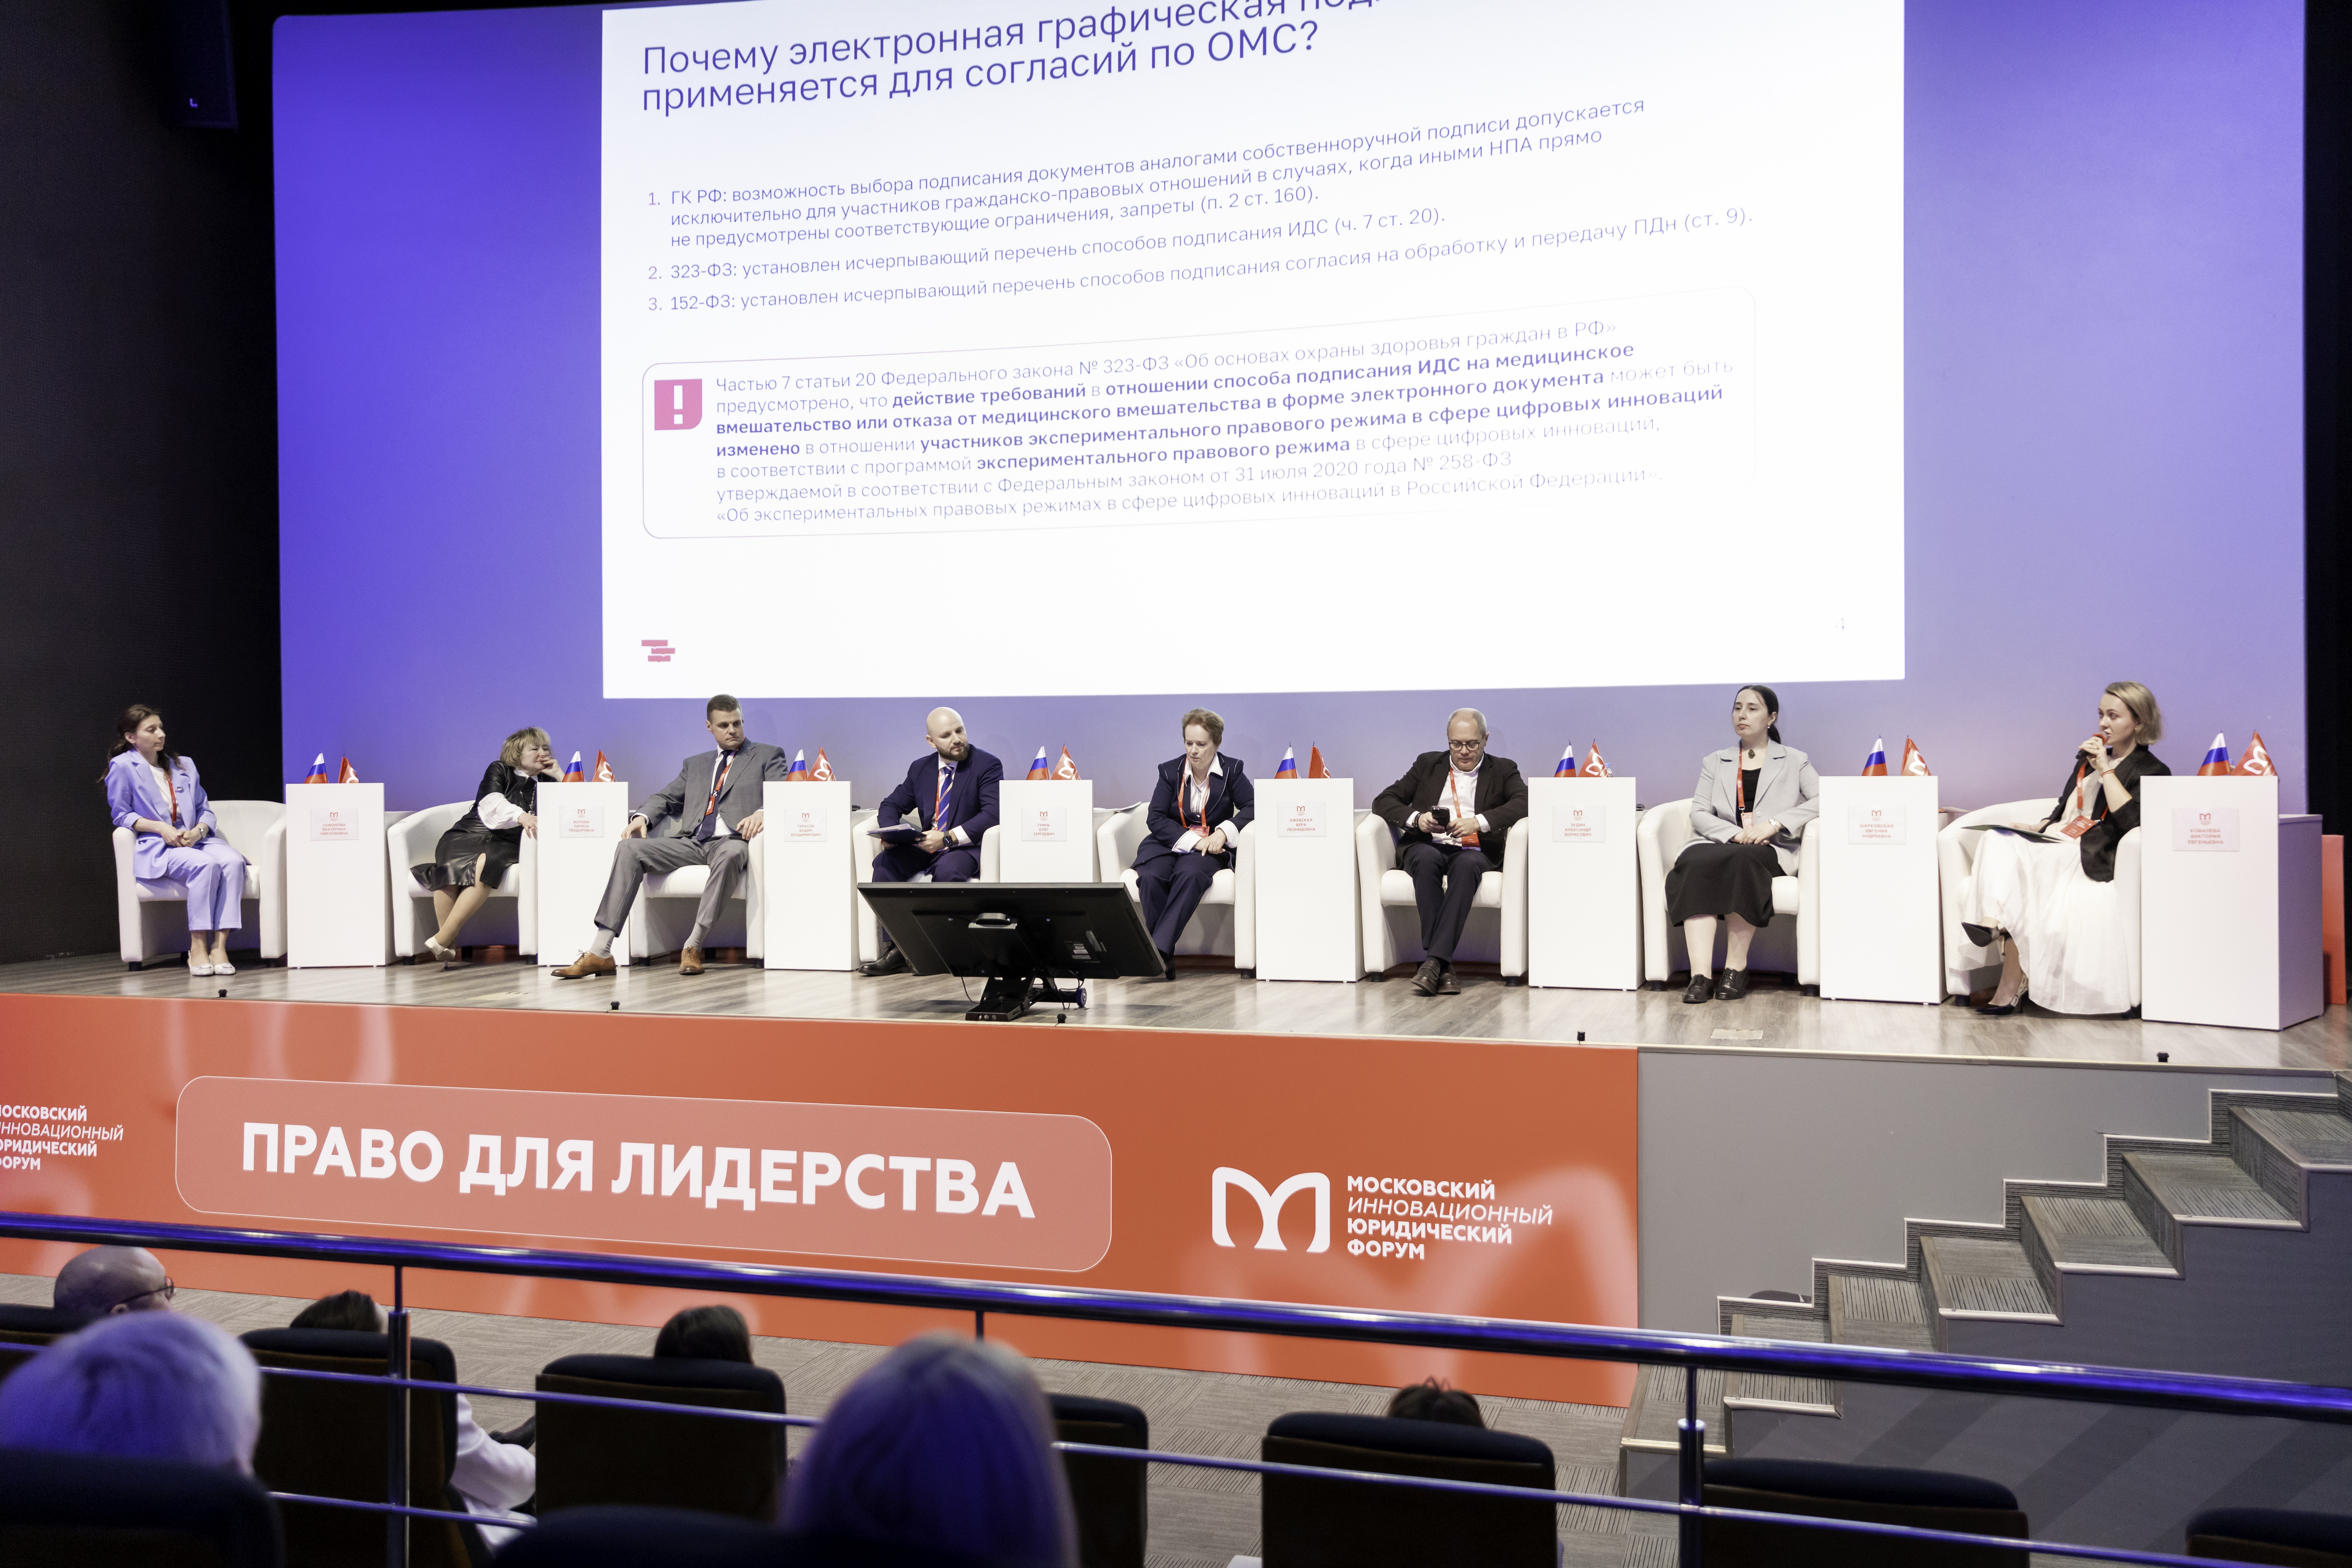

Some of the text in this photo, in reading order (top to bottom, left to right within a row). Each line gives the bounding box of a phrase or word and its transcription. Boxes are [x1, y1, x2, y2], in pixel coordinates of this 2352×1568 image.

[644, 20, 1317, 117] применяется для согласий по ОМС?
[645, 0, 1285, 75] Почему электронная графическая
[649, 100, 1643, 205] 1. ГК РФ: возможность выбора подписания документов аналогами собственноручной подписи допускается
[672, 131, 1601, 225] исключительно для участников гражданско-правовых отношений в случаях, когда иными НПА прямо
[649, 208, 1444, 279] 2. 323-ФЗ: установлен исчерпывающий перечень способов подписания ИДС (ч. 7 ст. 20).
[672, 186, 1318, 248] не предусмотрены соответствующие ограничения, запреты (п. 2 ст. 160).
[649, 208, 1752, 311] 3. 152-ФЗ: установлен исчерпывающий перечень способов подписания согласия на обработку и передачу ПДн (ст. 9).
[717, 320, 1615, 391] Частью 7 статьи 20 Федерального закона № 323-ФЗ «Об основах охраны здоровья граждан в РФ»
[717, 346, 1633, 415] предусмотрено, что действие требований в отношении способа подписания ИДС на медицинское
[717, 361, 1732, 434] вмешательство или отказа от медицинского вмешательства в форме электронного документа может быть
[717, 384, 1722, 456] изменено в отношении участников экспериментального правового режима в сфере цифровых инноваций
[0, 1104, 87, 1121] ОСКОВСКИЙ
[0, 1121, 124, 1141] ННОВАЦИОННЫЙ
[0, 1139, 97, 1156] РИДИЧЕСКИЙ
[0, 1156, 40, 1170] ОРУМ
[243, 1122, 1036, 1218] ПРАВО ДЛЯ ЛИДЕРСТВА
[1347, 1175, 1495, 1199] МОСКОВСКИЙ
[1347, 1218, 1512, 1244] ЮРИДИЧЕСКИЙ
[1348, 1197, 1553, 1224] ИННОВАЦИОННЫЙ
[1347, 1238, 1425, 1259] ФОРУМ
